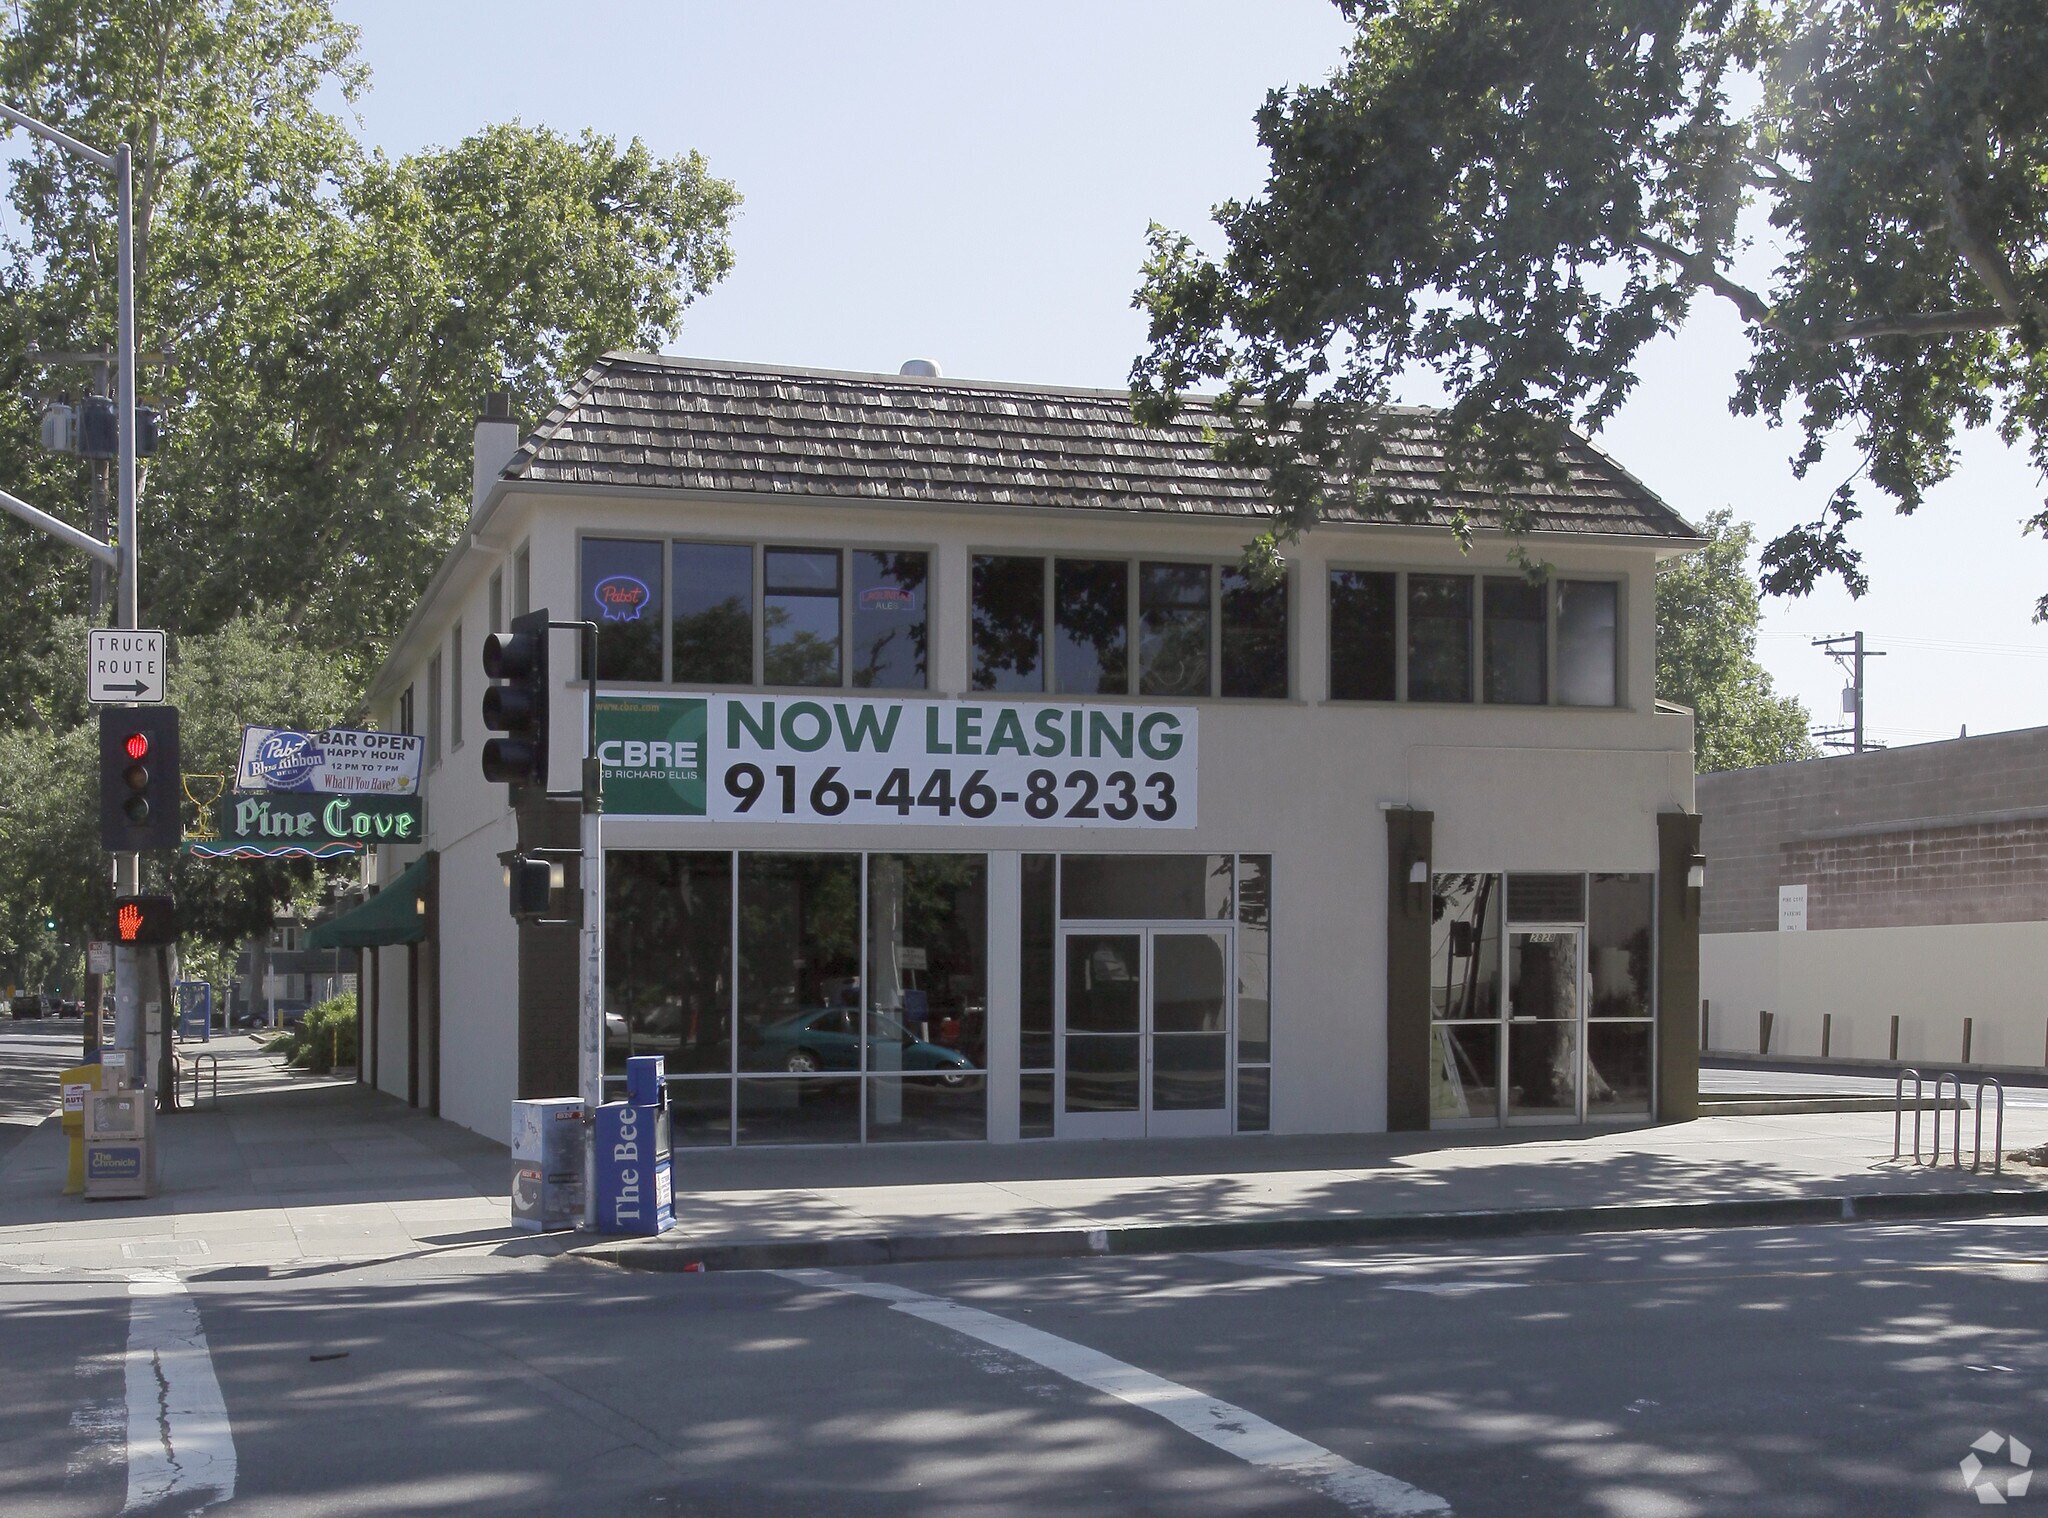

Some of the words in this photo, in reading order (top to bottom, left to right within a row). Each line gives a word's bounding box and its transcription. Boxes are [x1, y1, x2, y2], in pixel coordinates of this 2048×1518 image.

[602, 585, 642, 604] Pabst
[876, 602, 898, 610] ALES
[98, 638, 156, 652] TRUCK
[98, 660, 155, 674] ROUTE
[726, 700, 903, 753] NOW
[926, 706, 1184, 761] LEASING
[318, 732, 357, 748] BAR
[363, 735, 415, 751] OPEN
[327, 748, 367, 759] HAPPY
[371, 751, 405, 761] HOUR
[597, 740, 698, 768] CBRE
[251, 761, 277, 776] Blue
[278, 753, 323, 769] Ribbon
[345, 763, 359, 771] PM
[325, 774, 354, 789] What'll
[355, 776, 371, 790] You
[371, 778, 396, 791] Have?
[616, 770, 666, 779] RICHARD
[669, 771, 698, 780] ELLIS
[724, 762, 1178, 822] 916-446-8233
[235, 797, 316, 837] Pine
[323, 798, 415, 839] Cove
[1530, 933, 1556, 942] 2828
[614, 1108, 638, 1163] Bee
[92, 1158, 136, 1168] Chronicle
[94, 1152, 112, 1161] The
[615, 1169, 640, 1226] The
